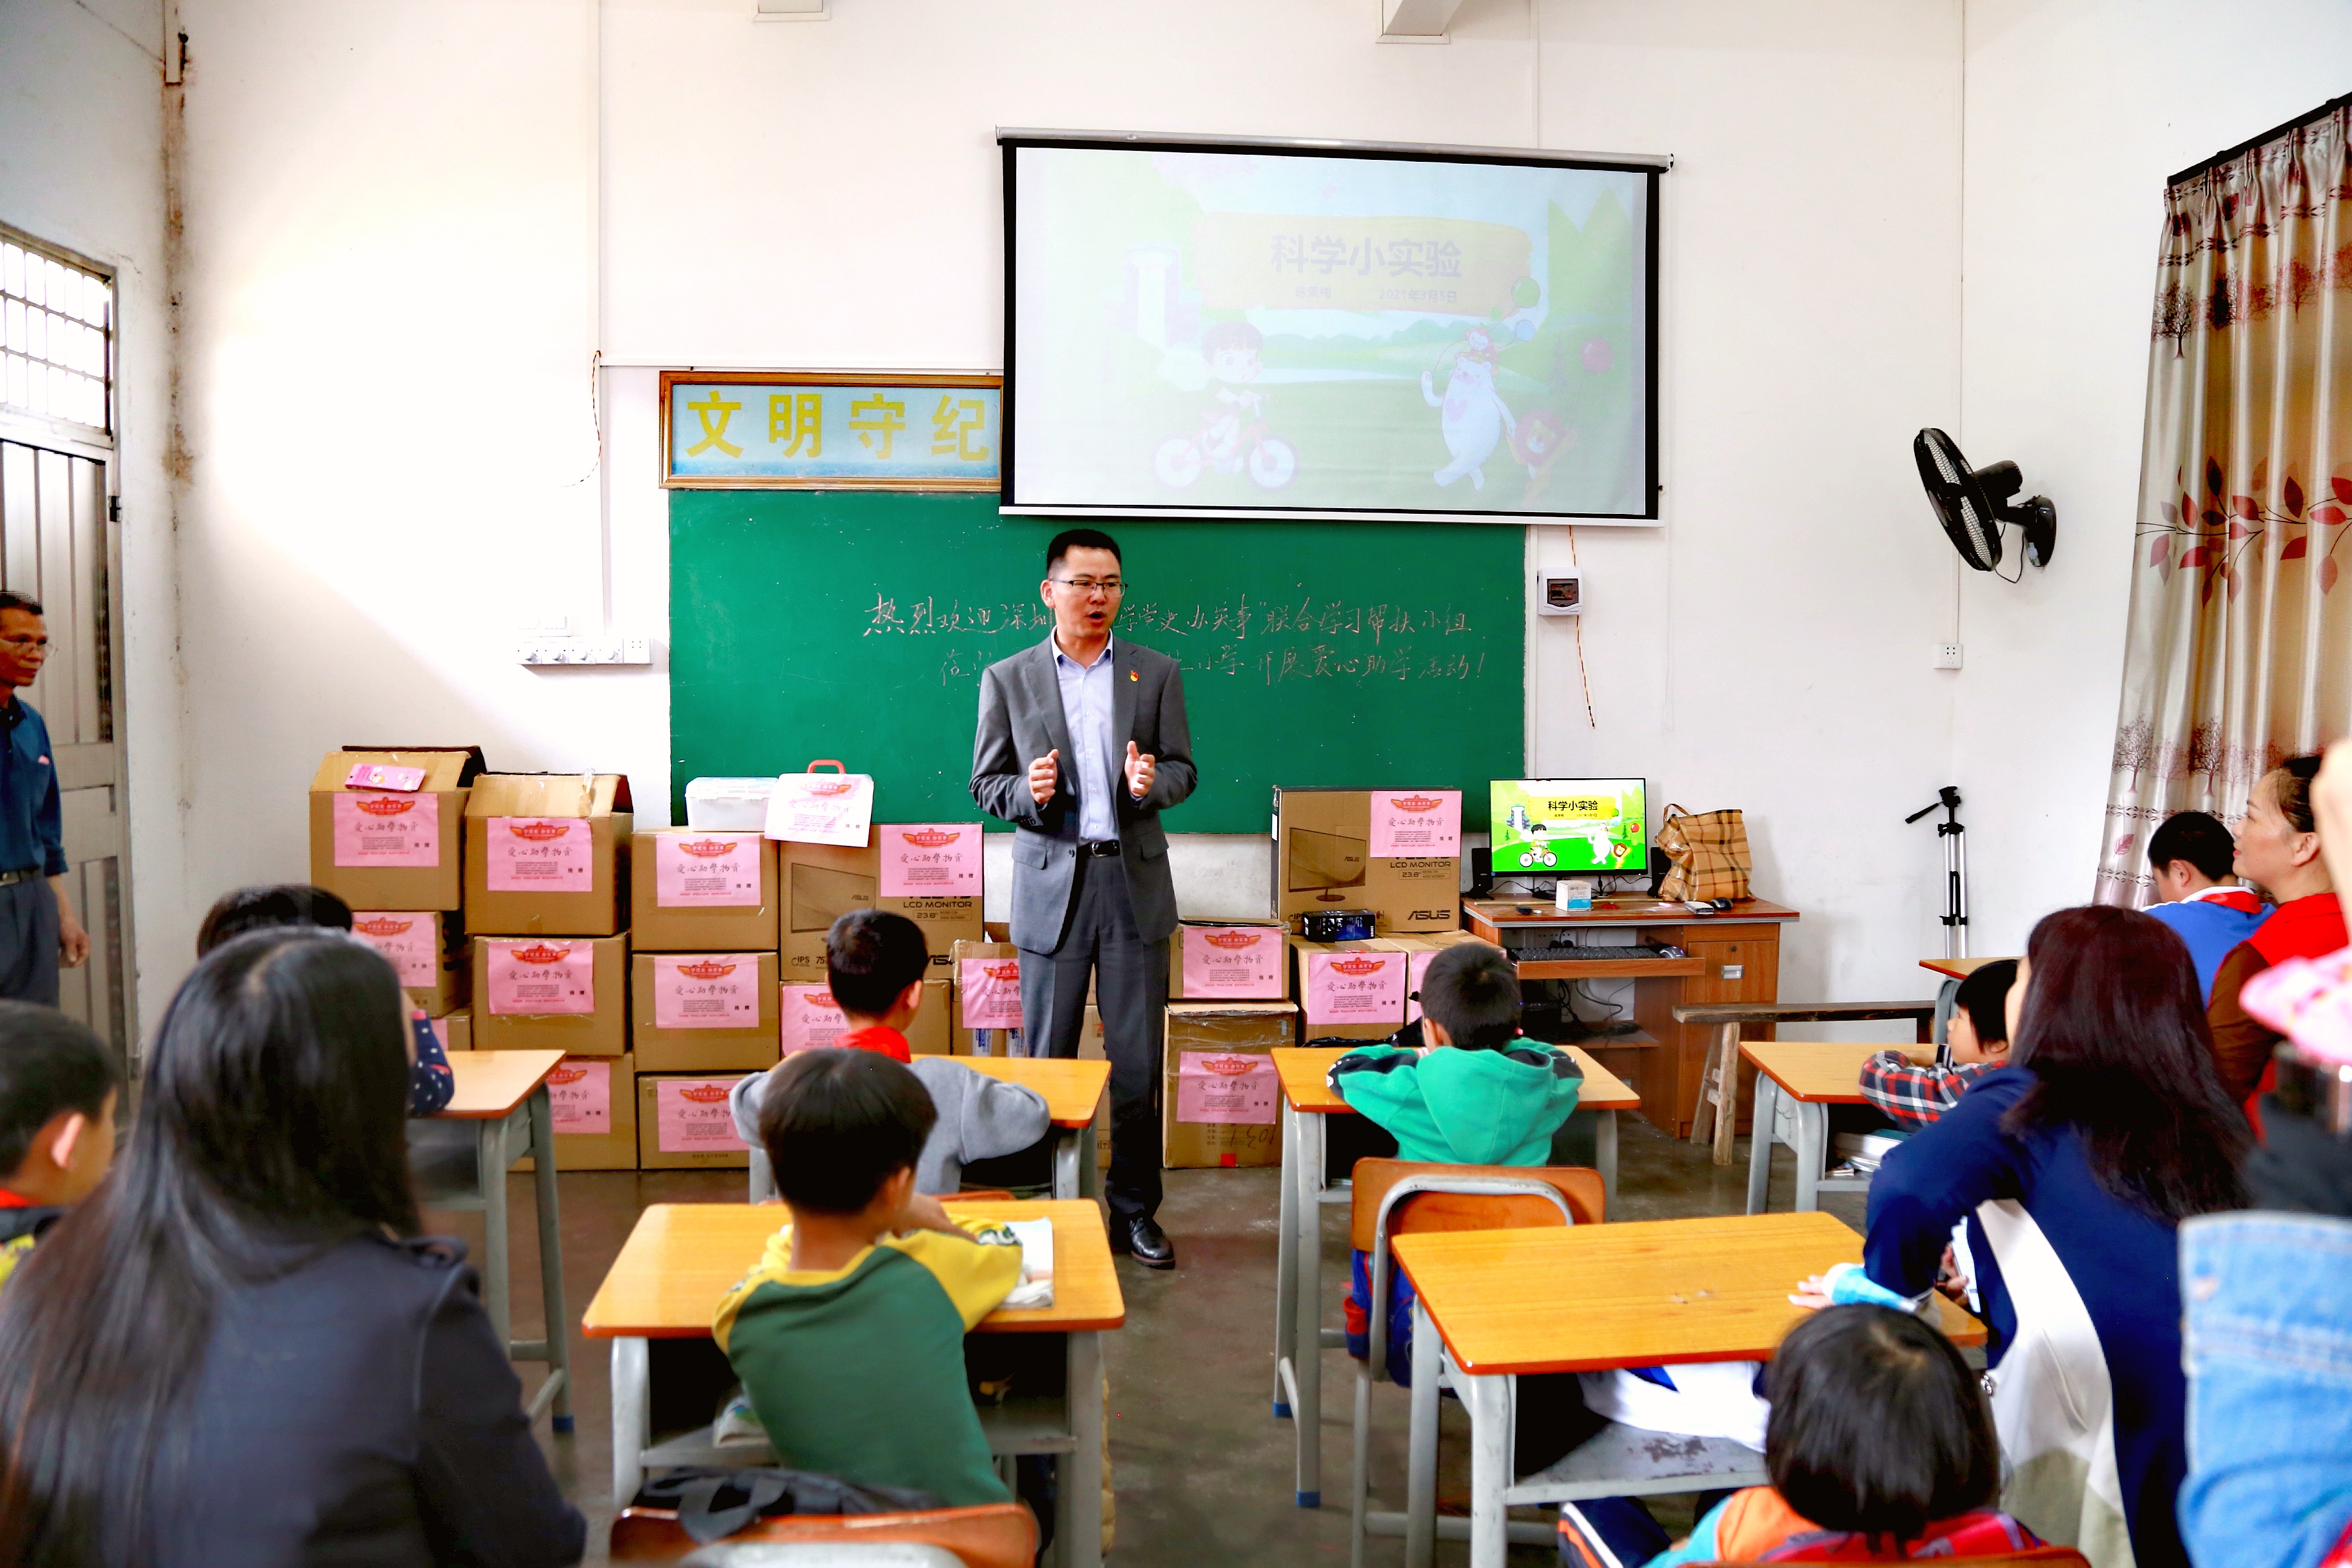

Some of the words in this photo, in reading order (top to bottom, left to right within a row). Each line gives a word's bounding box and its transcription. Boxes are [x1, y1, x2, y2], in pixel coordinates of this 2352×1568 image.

[1270, 233, 1462, 278] 科学小实验
[1379, 289, 1457, 304] 2021年3月5日
[685, 390, 990, 462] 文明守纪
[1548, 800, 1598, 811] 科学小实验
[1408, 910, 1451, 921] ASUS
